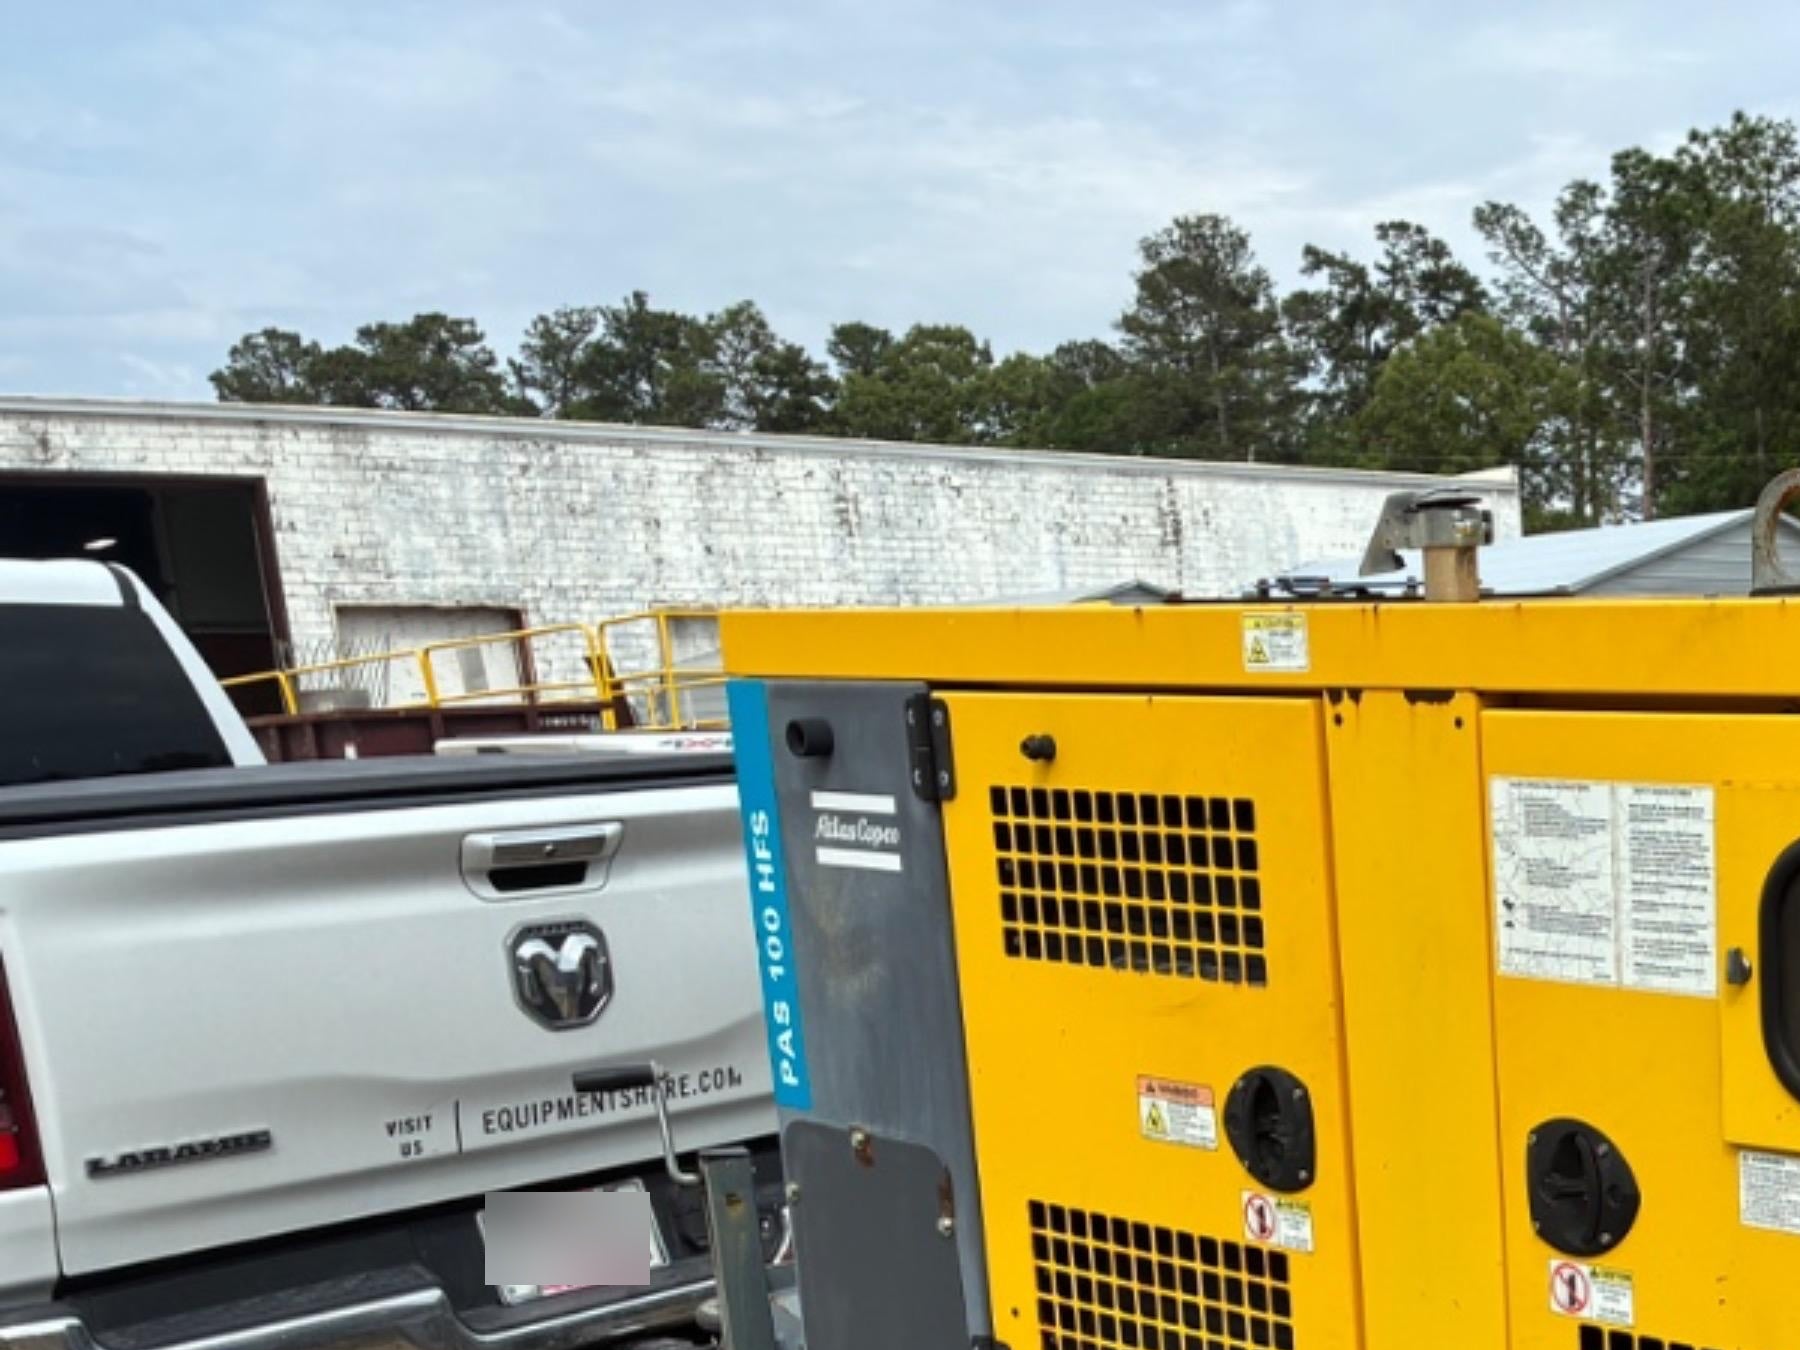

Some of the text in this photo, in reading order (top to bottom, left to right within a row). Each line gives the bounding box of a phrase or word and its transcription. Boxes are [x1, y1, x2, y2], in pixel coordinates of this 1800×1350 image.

[815, 814, 856, 841] Atlas
[750, 809, 799, 1087] PAS 100 HFS
[385, 1114, 433, 1138] VISIT
[401, 1139, 424, 1157] US
